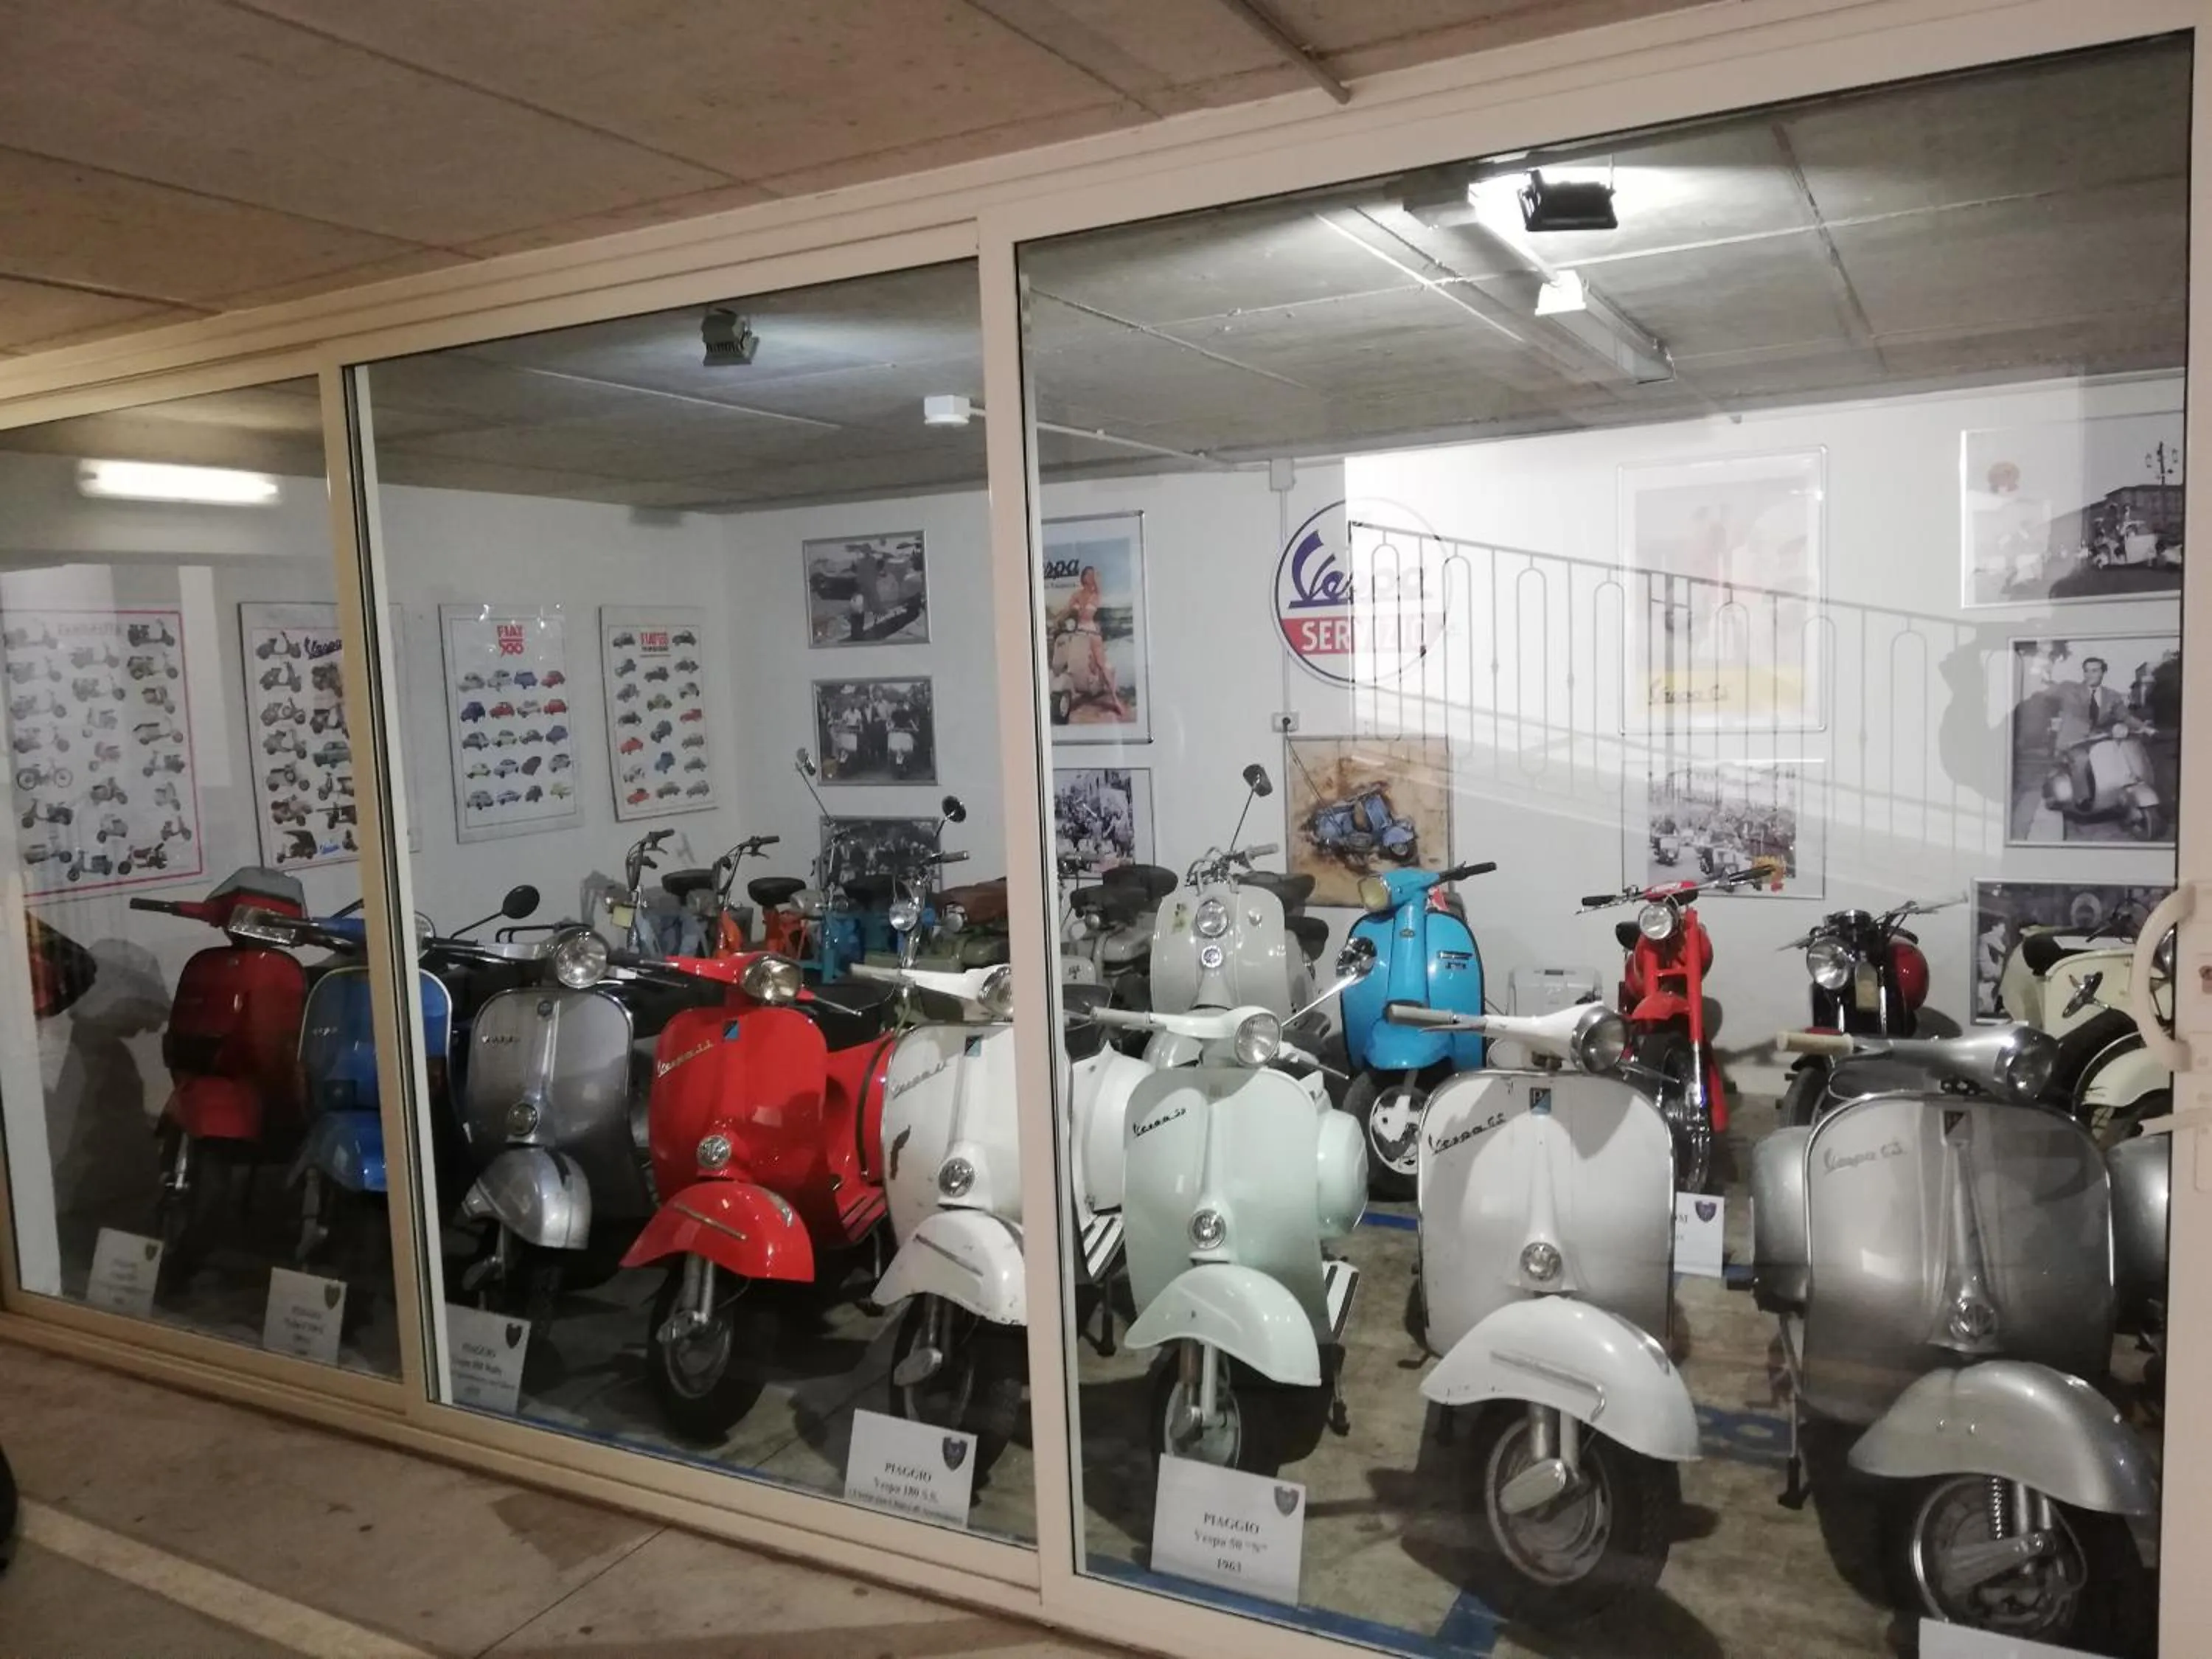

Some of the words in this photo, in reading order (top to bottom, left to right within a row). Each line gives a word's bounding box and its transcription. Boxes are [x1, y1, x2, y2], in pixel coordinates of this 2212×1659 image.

[885, 1462, 931, 1483] PIAGGIO
[873, 1476, 901, 1494] Vespa
[1203, 1512, 1261, 1534] PIAGGIO
[1194, 1528, 1226, 1548] Vespa
